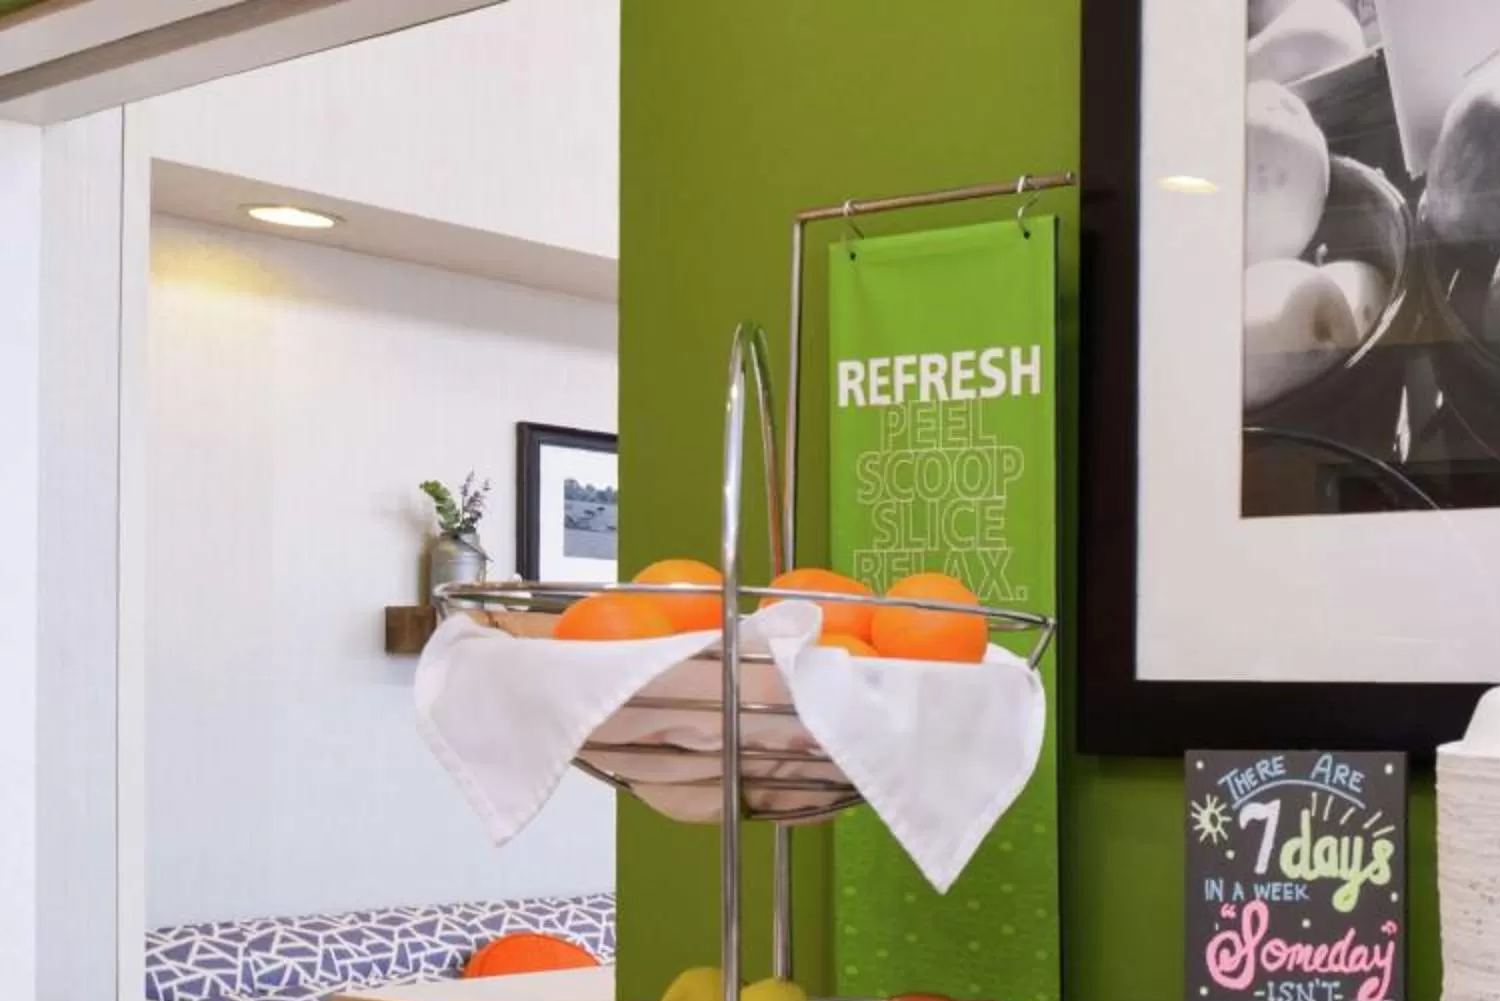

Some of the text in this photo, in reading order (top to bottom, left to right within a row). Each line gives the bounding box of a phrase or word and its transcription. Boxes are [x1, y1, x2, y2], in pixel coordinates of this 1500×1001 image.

[837, 344, 1041, 408] REFRESH
[880, 397, 997, 451] PEEL
[856, 445, 1025, 505] SCOOP
[871, 498, 1008, 552] SLICE
[1217, 753, 1366, 801] THERE ARE
[1238, 799, 1395, 913] 7 days
[1204, 877, 1311, 901] IN A WEEK
